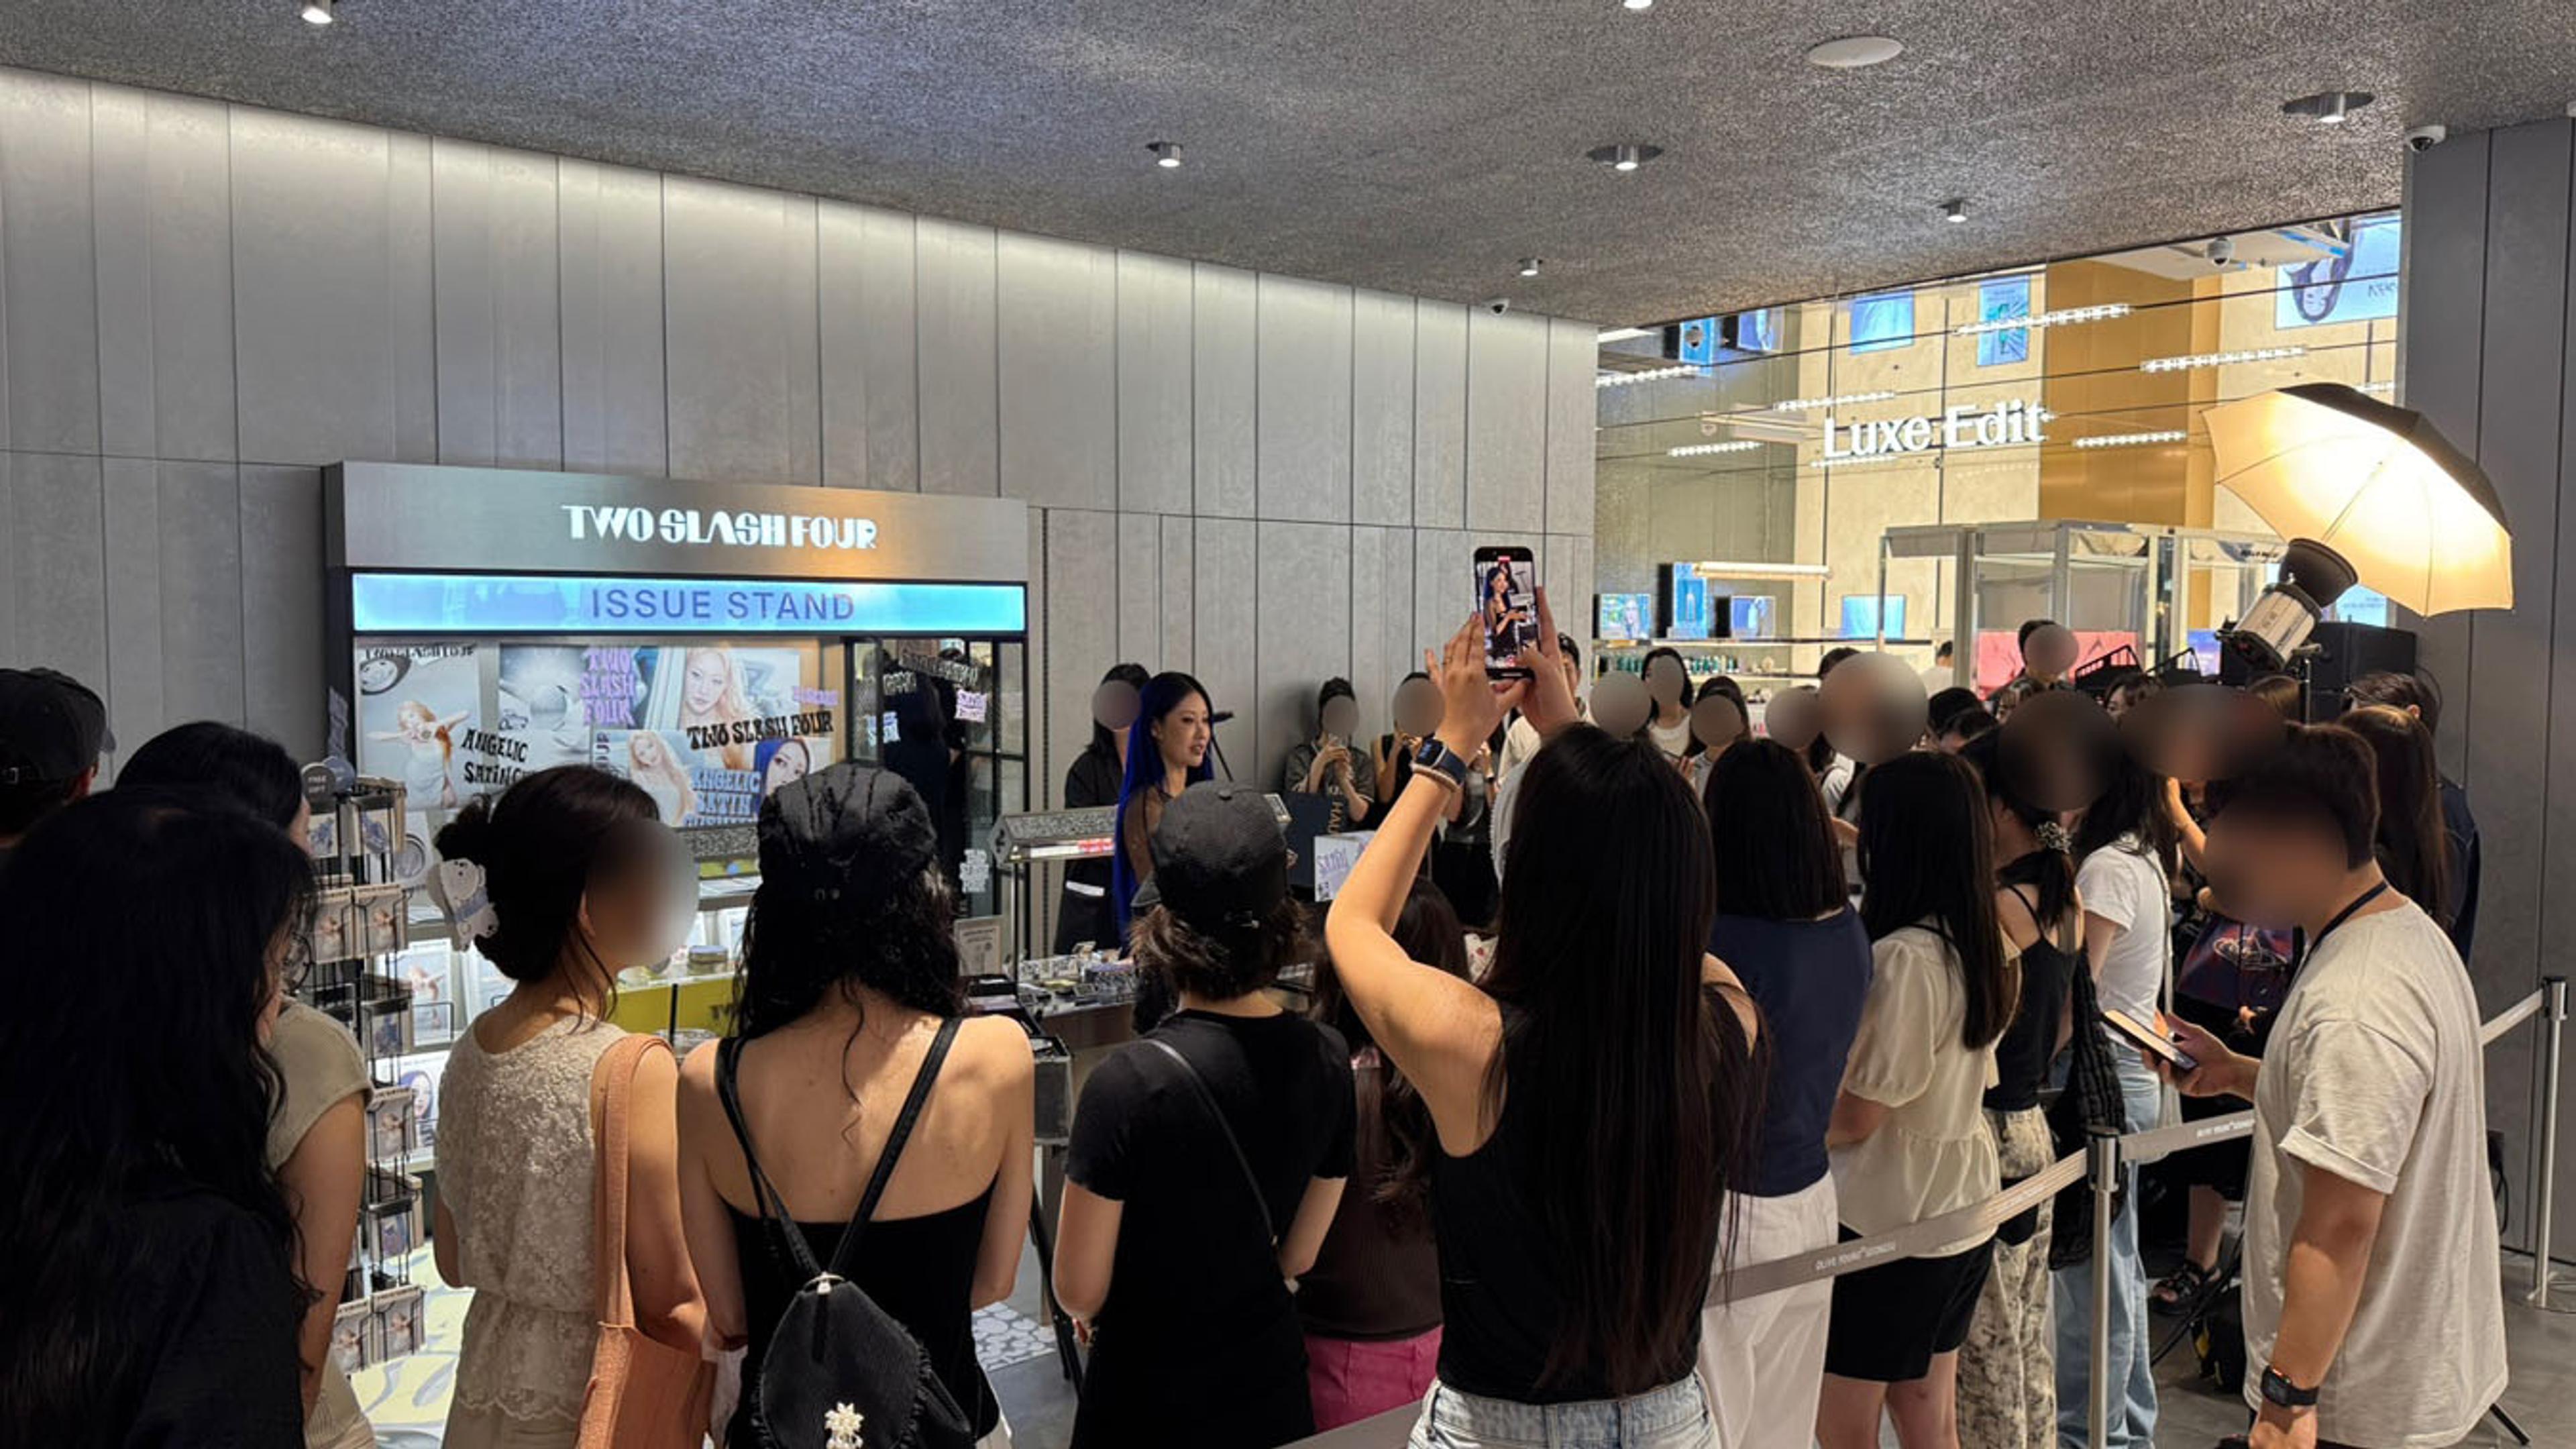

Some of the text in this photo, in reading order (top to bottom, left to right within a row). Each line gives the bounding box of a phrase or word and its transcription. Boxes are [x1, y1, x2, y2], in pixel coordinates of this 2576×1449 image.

[1824, 398, 2048, 458] Luxe Edit
[561, 505, 877, 549] TWO SLASH FOUR
[592, 588, 855, 620] ISSUE STAND
[582, 647, 631, 673] TWO
[580, 672, 635, 698] SLASH
[583, 698, 635, 726] FOUR
[686, 710, 834, 750] TWO SLASH FOUR
[460, 728, 529, 763] ANGELIC
[690, 767, 762, 793] ANGELIC
[696, 792, 753, 816] SATIN
